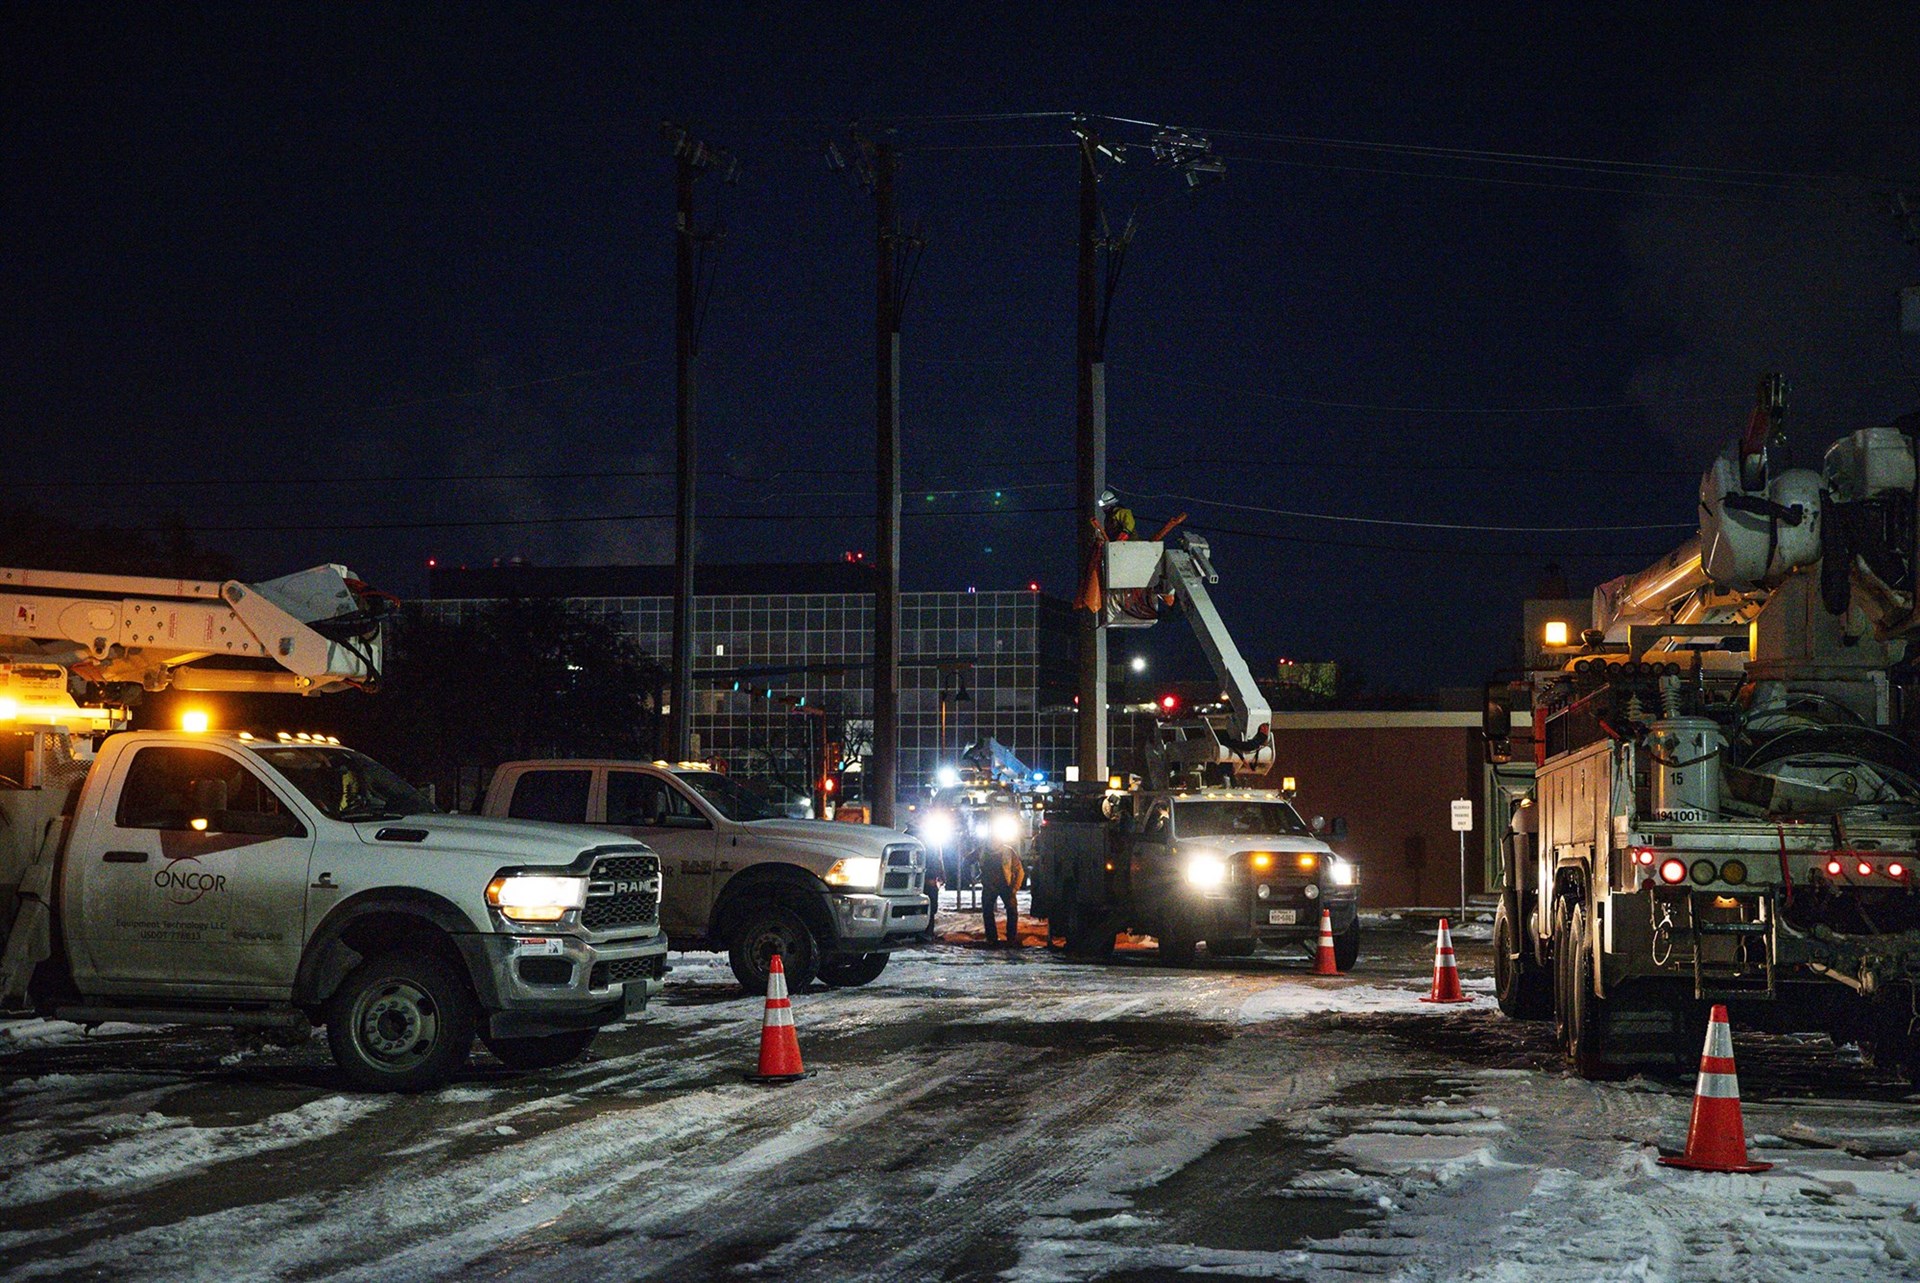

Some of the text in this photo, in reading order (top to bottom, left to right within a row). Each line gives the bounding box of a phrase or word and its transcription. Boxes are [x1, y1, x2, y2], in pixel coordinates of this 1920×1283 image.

[1671, 772, 1683, 785] 15
[154, 870, 226, 893] ONCOR
[616, 880, 652, 893] RAM
